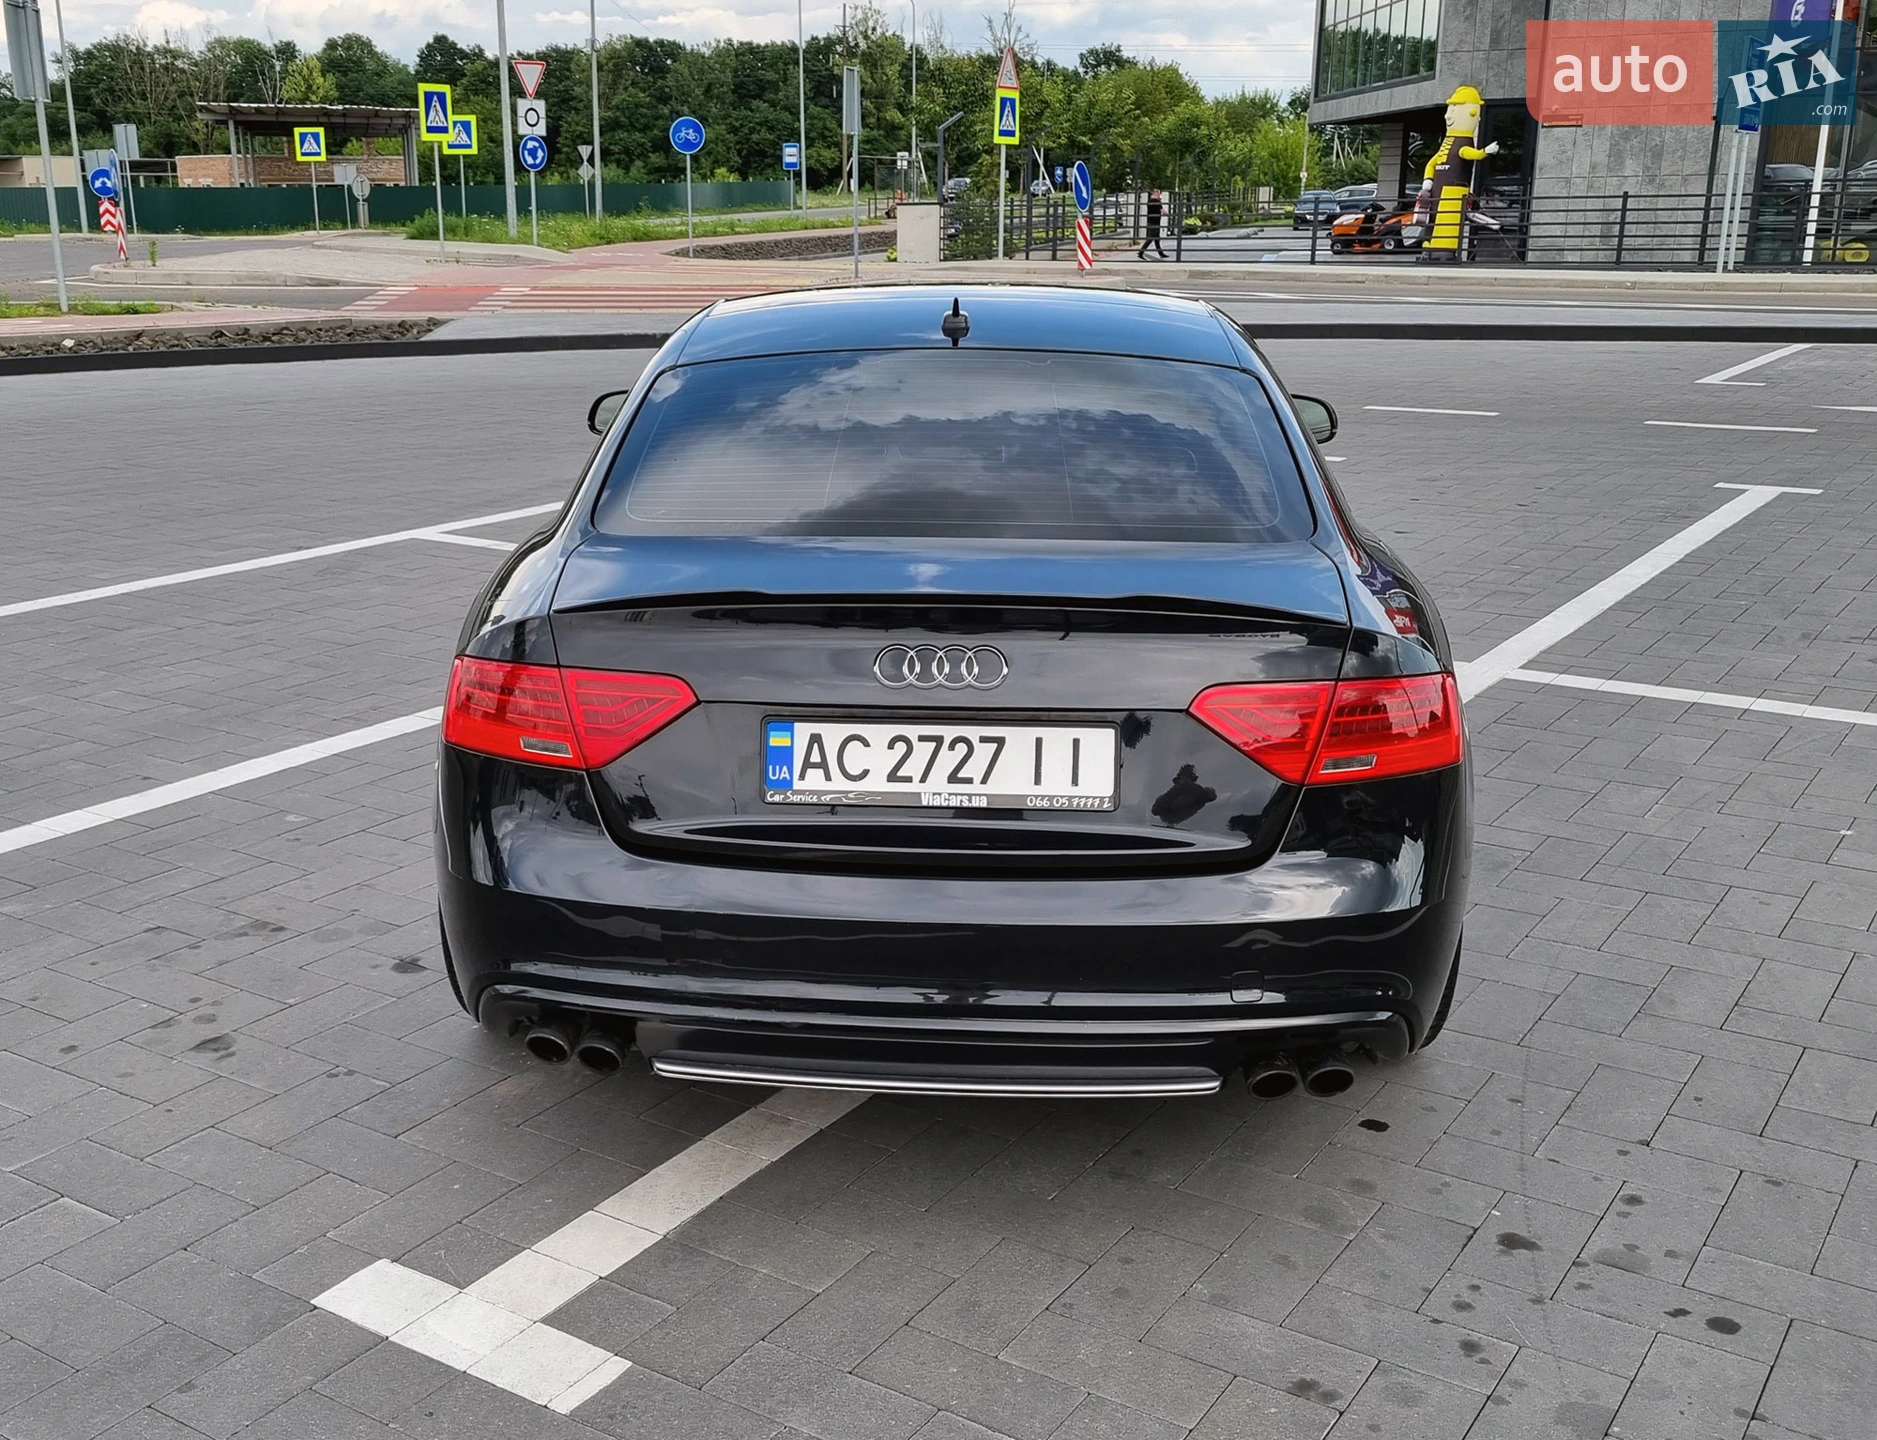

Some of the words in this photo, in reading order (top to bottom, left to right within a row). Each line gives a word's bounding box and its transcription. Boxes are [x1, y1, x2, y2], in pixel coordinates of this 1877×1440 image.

[797, 732, 871, 783] AC
[886, 734, 1007, 785] 2727
[1033, 736, 1081, 787] II
[768, 765, 791, 780] UA
[766, 790, 785, 802] Car
[786, 790, 819, 803] Service
[920, 792, 988, 807] ViaCars.ua
[1026, 796, 1051, 808] 066
[1052, 796, 1069, 808] 05
[1071, 797, 1101, 809] 7777
